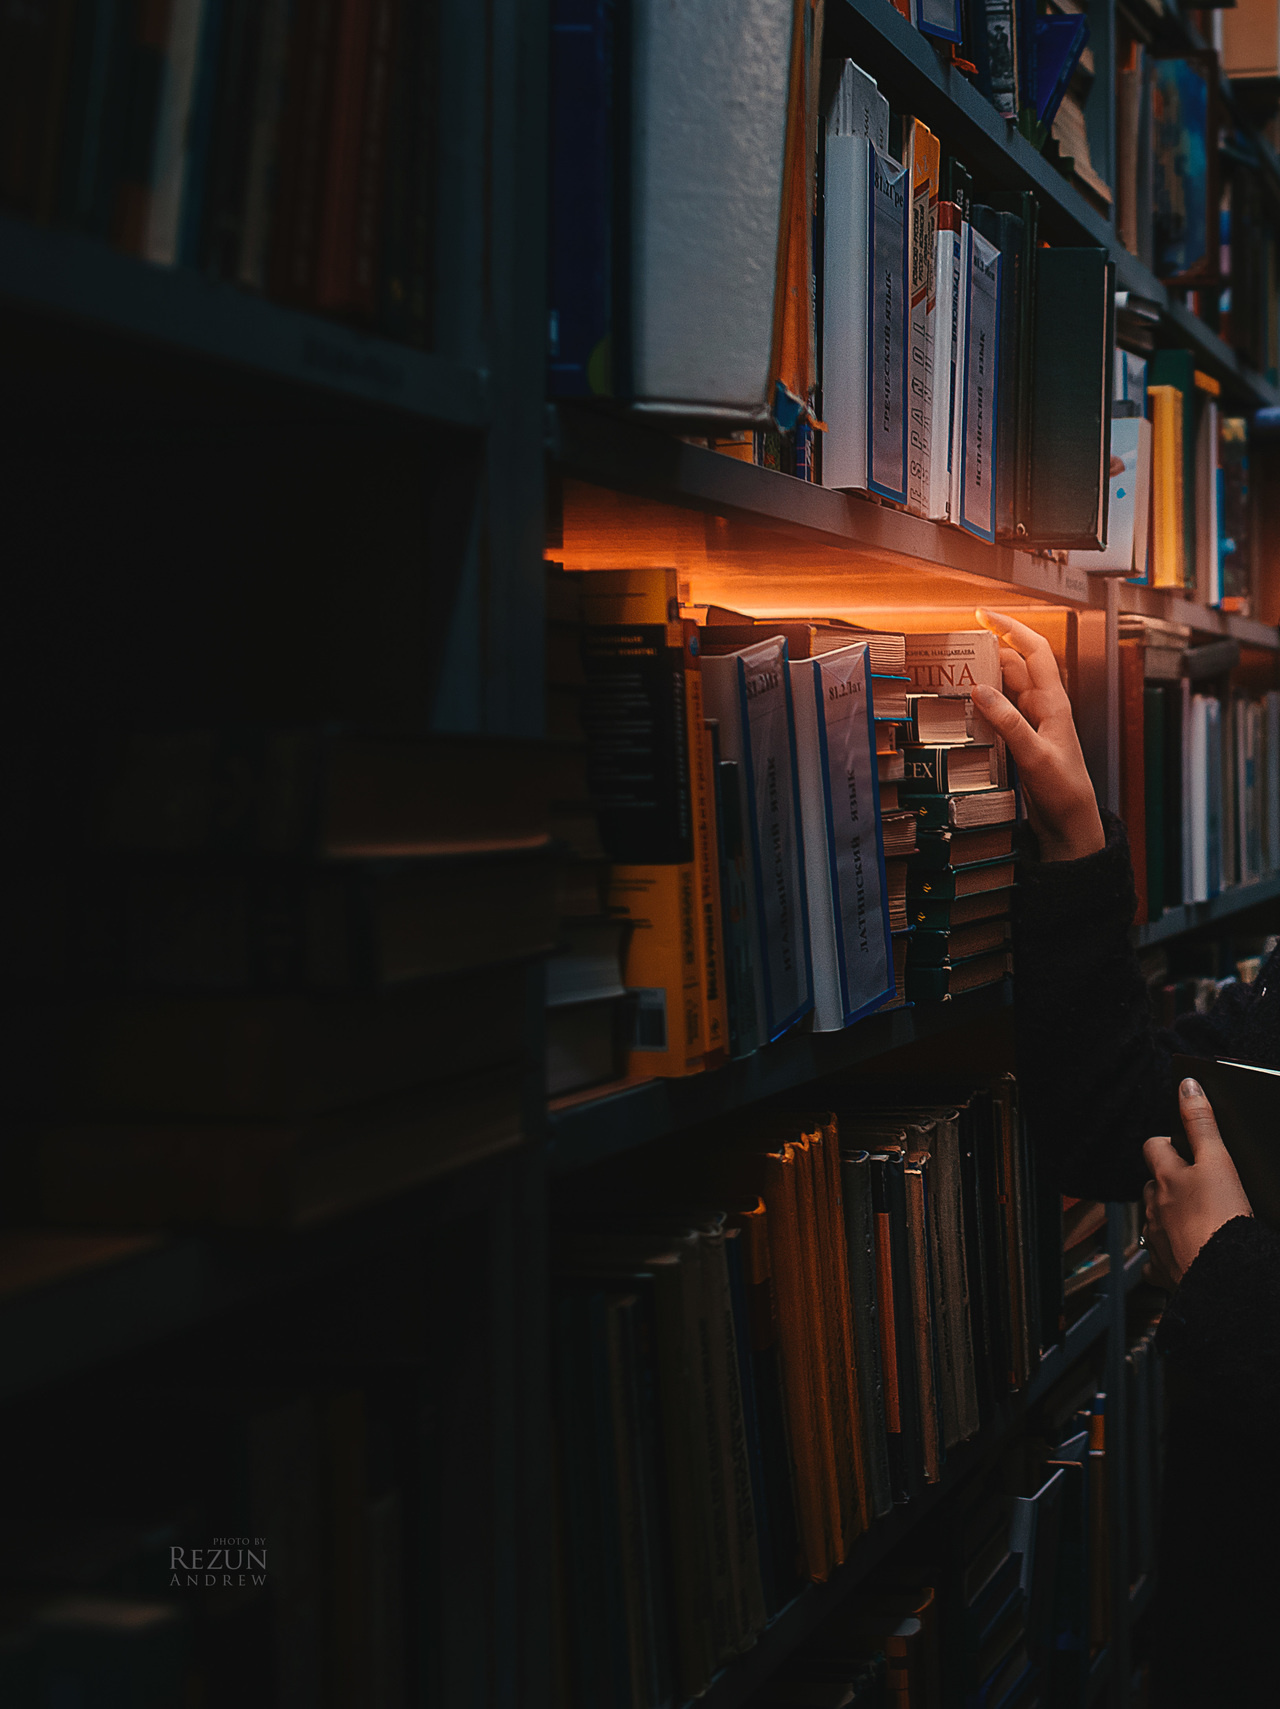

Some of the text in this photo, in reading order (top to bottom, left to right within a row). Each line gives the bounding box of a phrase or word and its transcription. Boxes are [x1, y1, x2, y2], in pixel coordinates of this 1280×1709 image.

[883, 269, 892, 322] ЯЗЫК
[976, 328, 986, 376] ЯЗЫК
[765, 756, 794, 973] ИТАЛЬЯНСКИЙ ЯЗЫК
[845, 767, 870, 953] ЛАТИНСКИЙ ЯЗЫК
